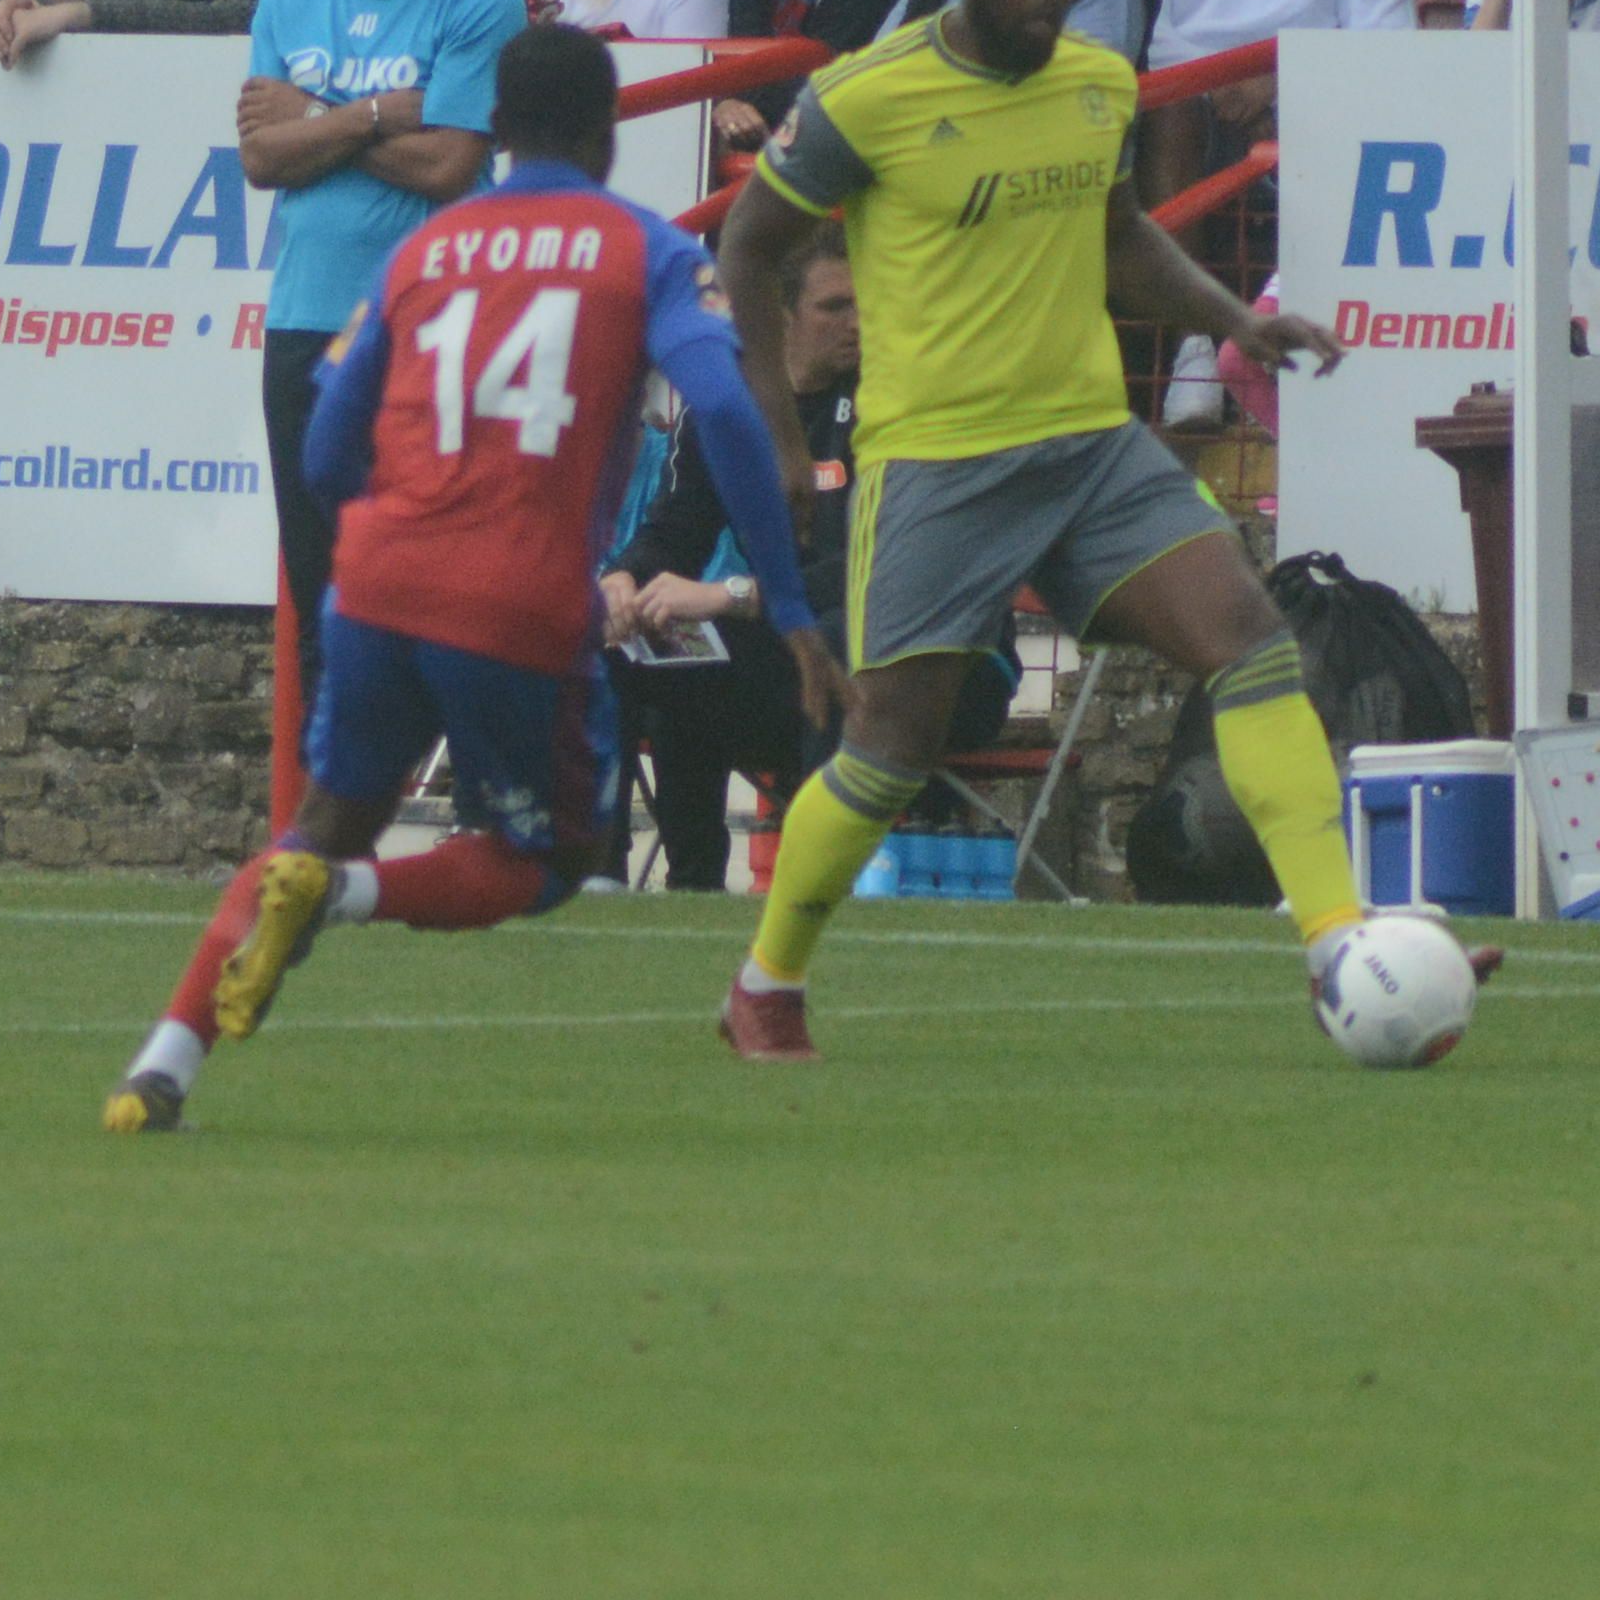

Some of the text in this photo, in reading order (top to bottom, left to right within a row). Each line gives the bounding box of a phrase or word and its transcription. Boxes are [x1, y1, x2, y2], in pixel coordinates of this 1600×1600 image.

[348, 12, 378, 38] AU
[333, 55, 418, 94] JAKO
[1006, 160, 1106, 200] STRIDE
[421, 226, 602, 280] EYOMA
[415, 287, 581, 458] 14
[1363, 954, 1399, 995] JAKO
